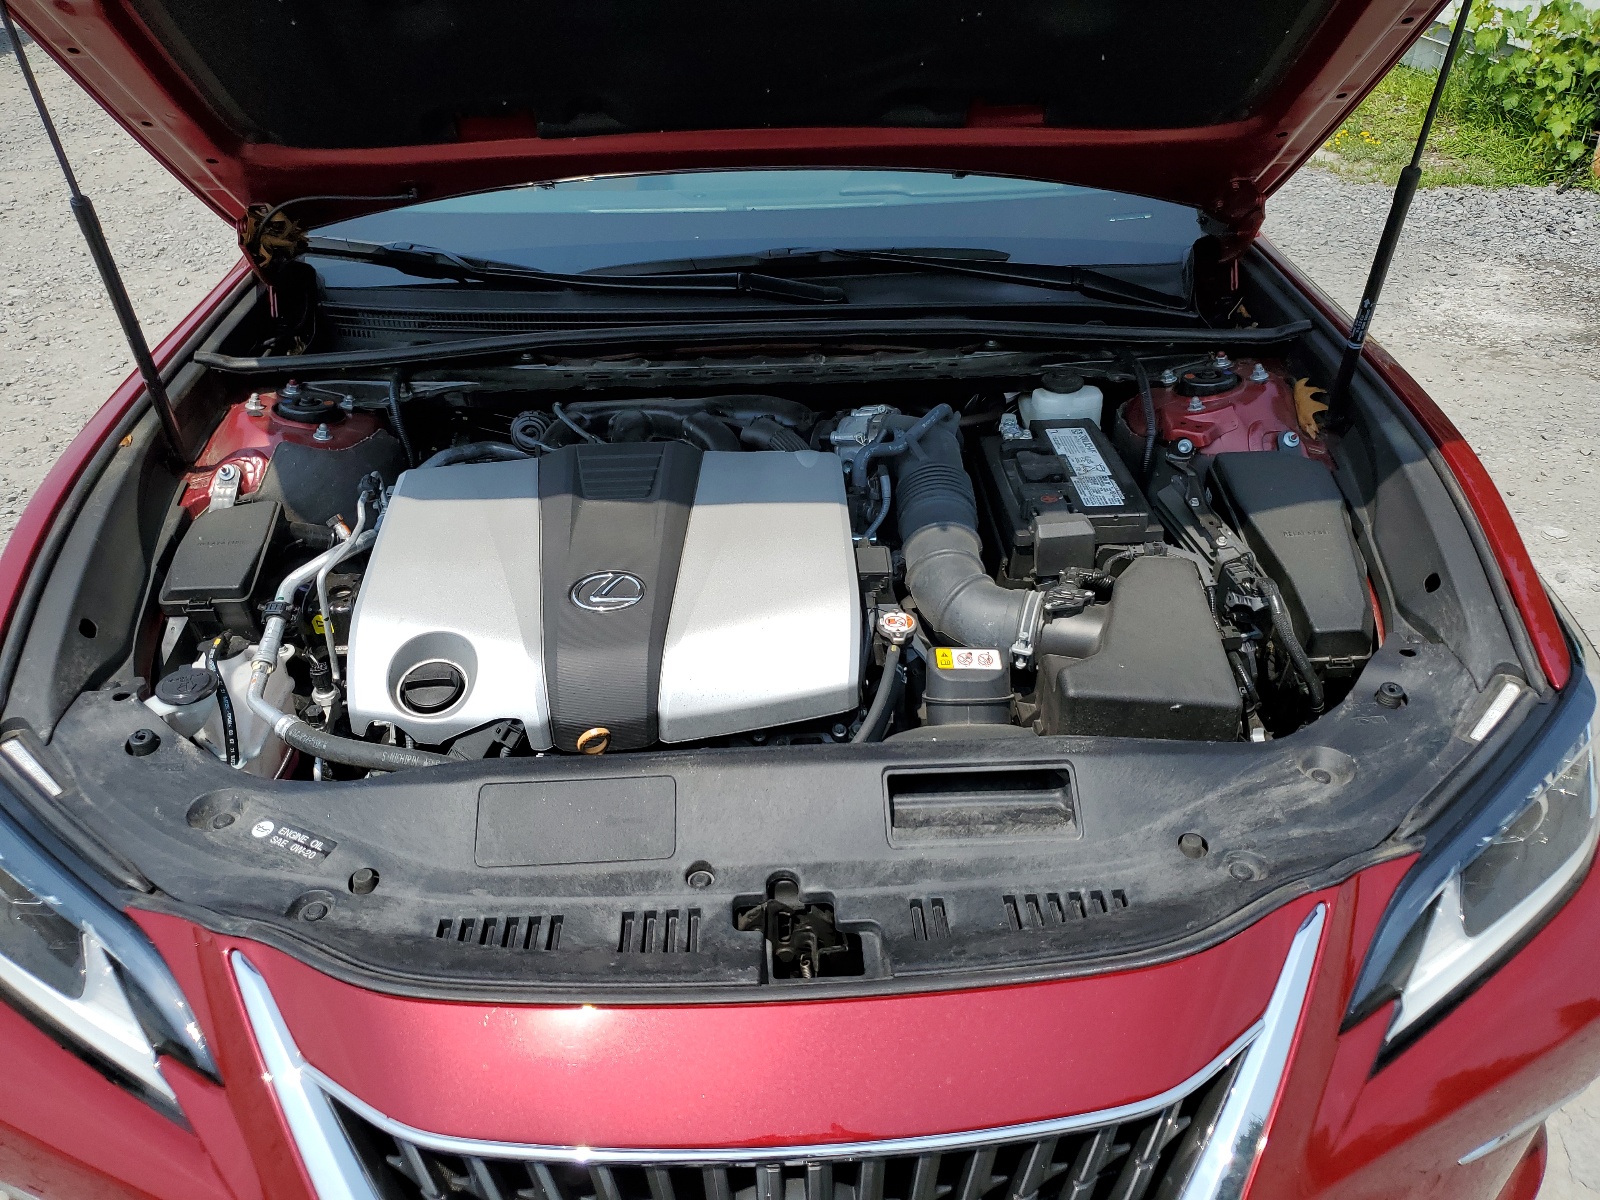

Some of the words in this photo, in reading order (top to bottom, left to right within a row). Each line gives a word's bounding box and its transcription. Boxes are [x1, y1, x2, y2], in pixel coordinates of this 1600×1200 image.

[269, 835, 290, 848] SAE
[289, 843, 317, 860] 0W-20
[278, 826, 310, 844] ENGINE
[310, 839, 325, 852] OIL
